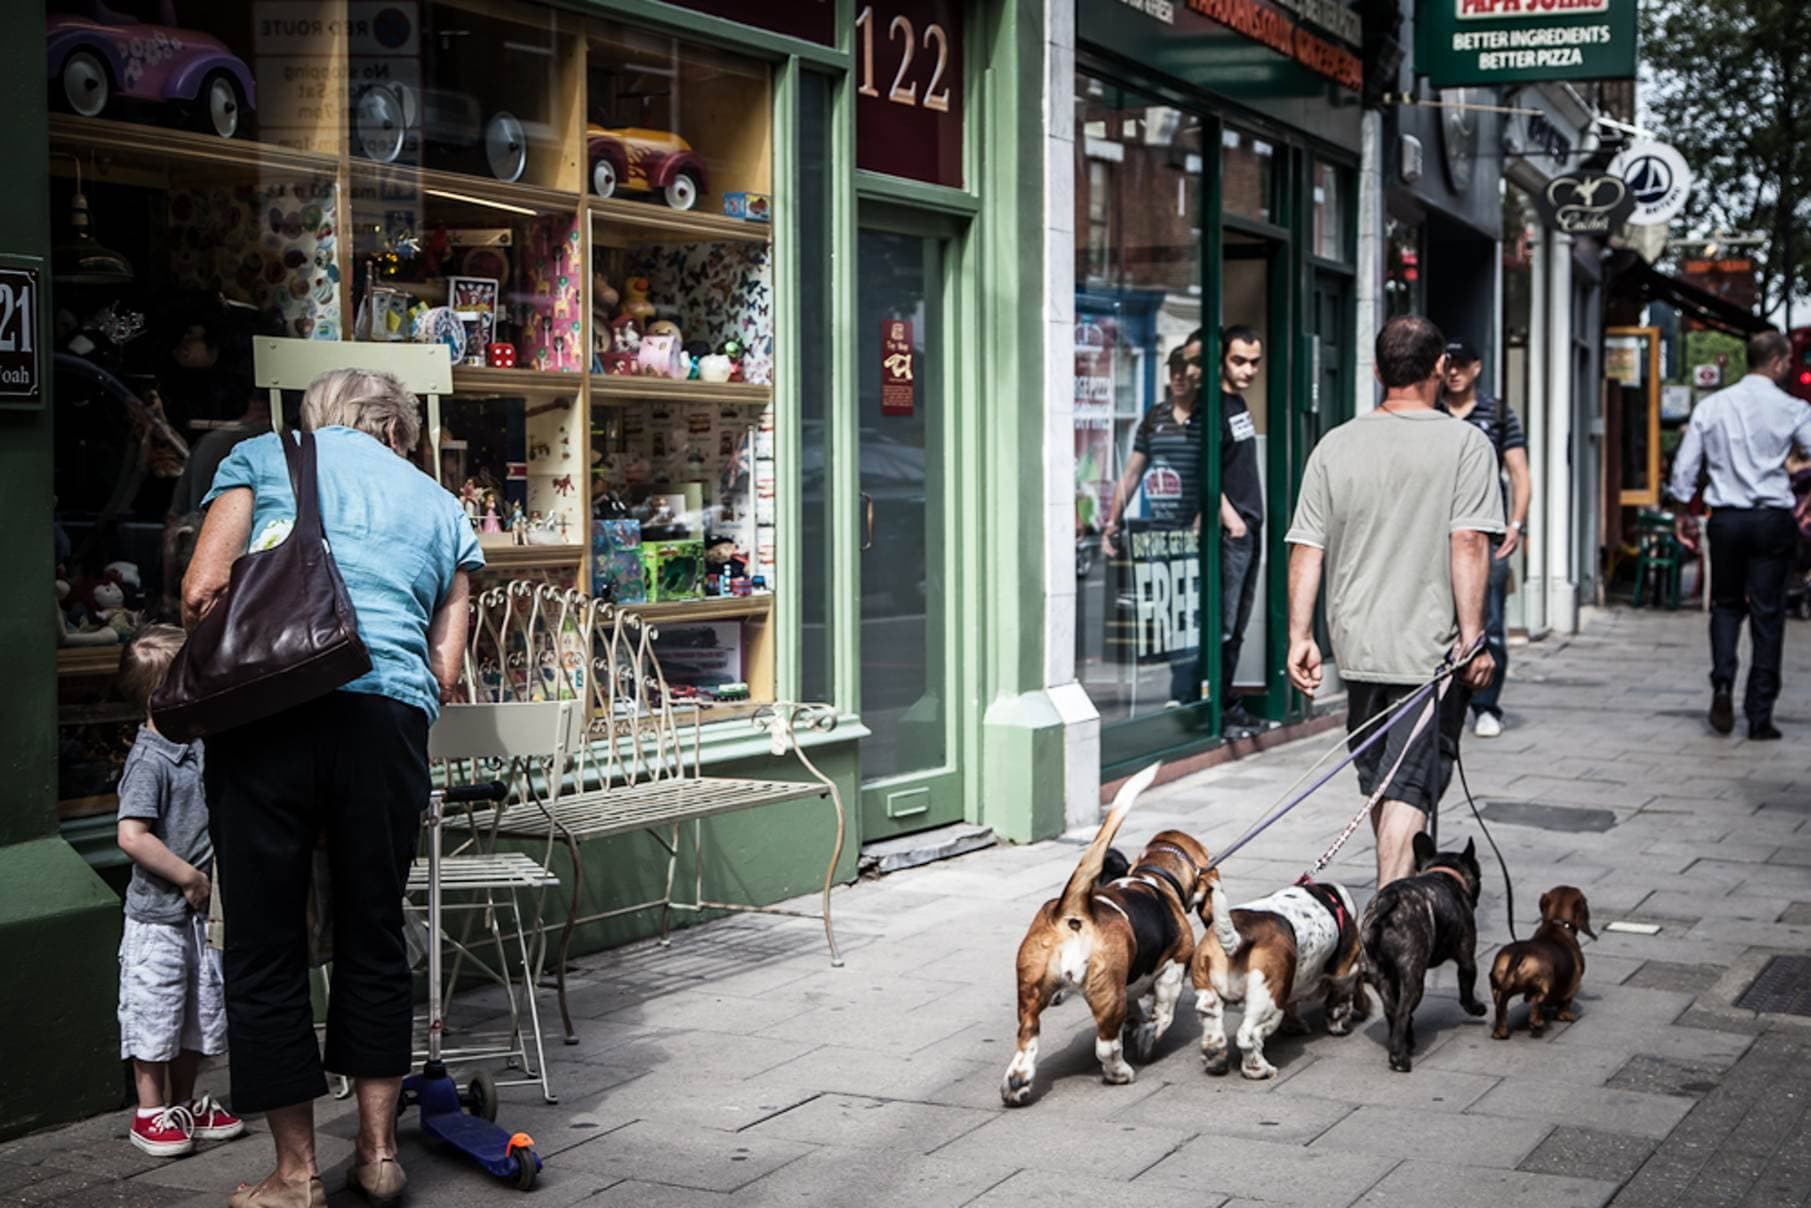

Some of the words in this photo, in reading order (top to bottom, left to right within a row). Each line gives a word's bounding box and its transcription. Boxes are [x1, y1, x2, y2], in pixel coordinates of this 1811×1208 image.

[856, 5, 949, 112] 122
[1453, 32, 1509, 50] BETTER
[1510, 25, 1611, 47] INGREDIENTS
[1478, 52, 1536, 70] BETTER
[1536, 47, 1583, 67] PIZZA
[1134, 558, 1200, 657] FREE
